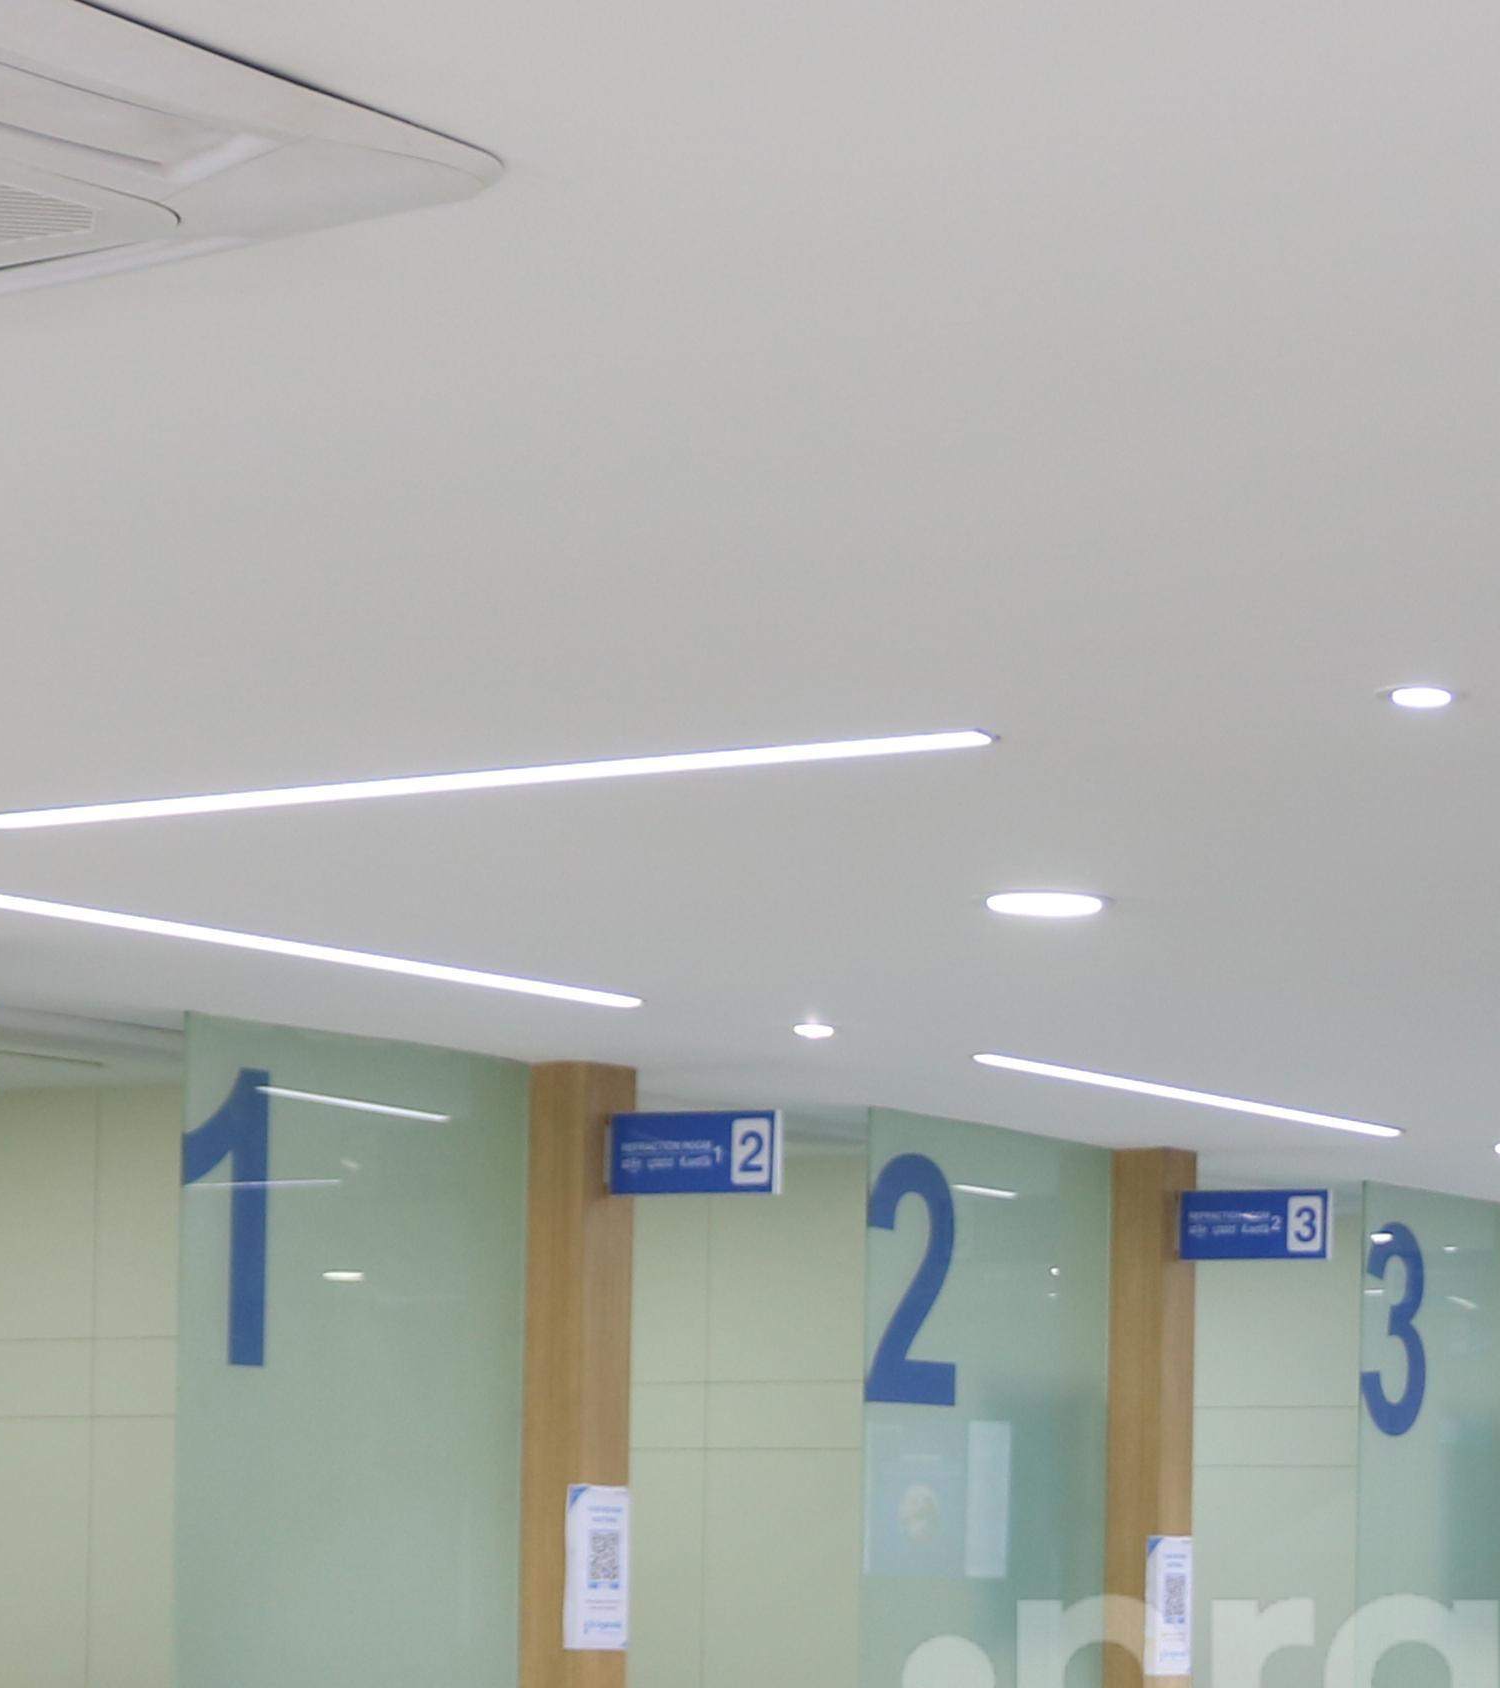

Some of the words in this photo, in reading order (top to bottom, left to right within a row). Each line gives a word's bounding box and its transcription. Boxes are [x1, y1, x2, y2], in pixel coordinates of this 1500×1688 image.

[713, 1145, 723, 1163] 1
[739, 1130, 764, 1173] 2
[182, 1068, 270, 1366] 1
[1270, 1215, 1282, 1232] 2
[1293, 1206, 1317, 1243] 3
[866, 1153, 957, 1406] 2
[1361, 1222, 1426, 1437] 3
